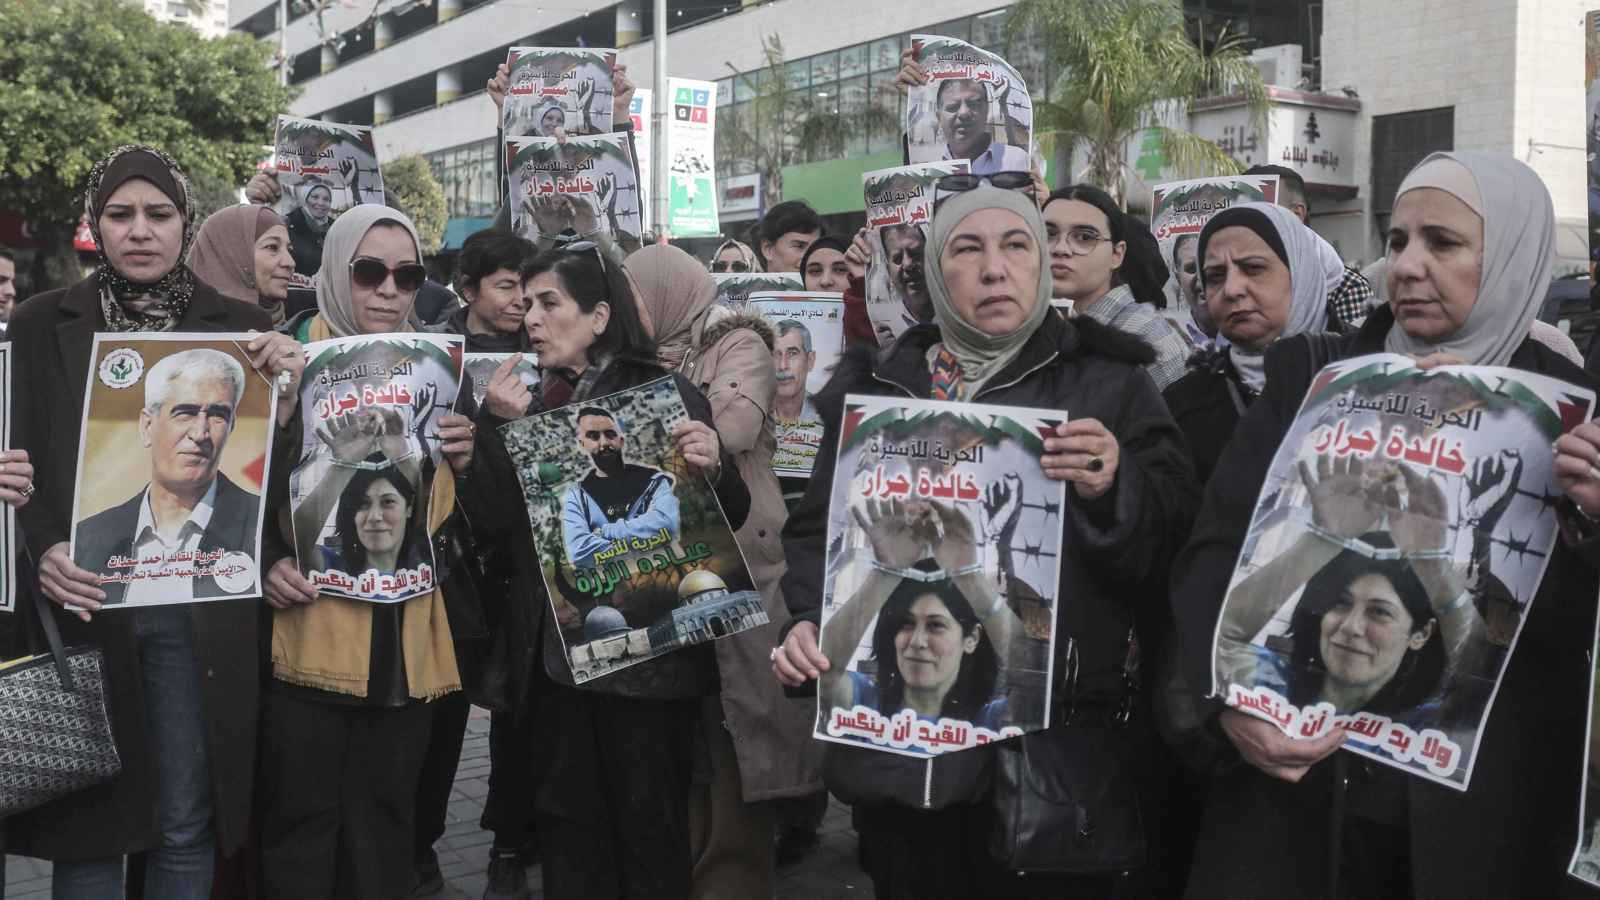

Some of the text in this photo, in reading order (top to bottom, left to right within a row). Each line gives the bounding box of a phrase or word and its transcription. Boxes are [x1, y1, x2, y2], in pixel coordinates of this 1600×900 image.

[563, 159, 594, 172] الحرية
[526, 174, 594, 197] خالدة جرار
[895, 185, 925, 203] الحرية
[908, 202, 930, 224] اهر
[1201, 197, 1231, 212] الحرية
[373, 362, 413, 381] الحرية
[320, 381, 412, 418] خالدة جرار
[1413, 396, 1482, 431] الحرية
[933, 440, 984, 465] الحرية
[1315, 420, 1467, 474] خالدة جرار
[862, 465, 980, 499] خالدة جرار
[632, 528, 672, 553] الحرية
[194, 548, 225, 564] الحرية
[312, 564, 431, 593] ولا بد للقيد أن ينكسر
[1233, 691, 1292, 729] ينكسر
[833, 711, 885, 738] ينكسر
[892, 715, 912, 742] أن
[1300, 709, 1329, 737] أن
[918, 725, 968, 747] للقيد
[1388, 729, 1412, 752] بد
[1421, 736, 1453, 769] ولا
